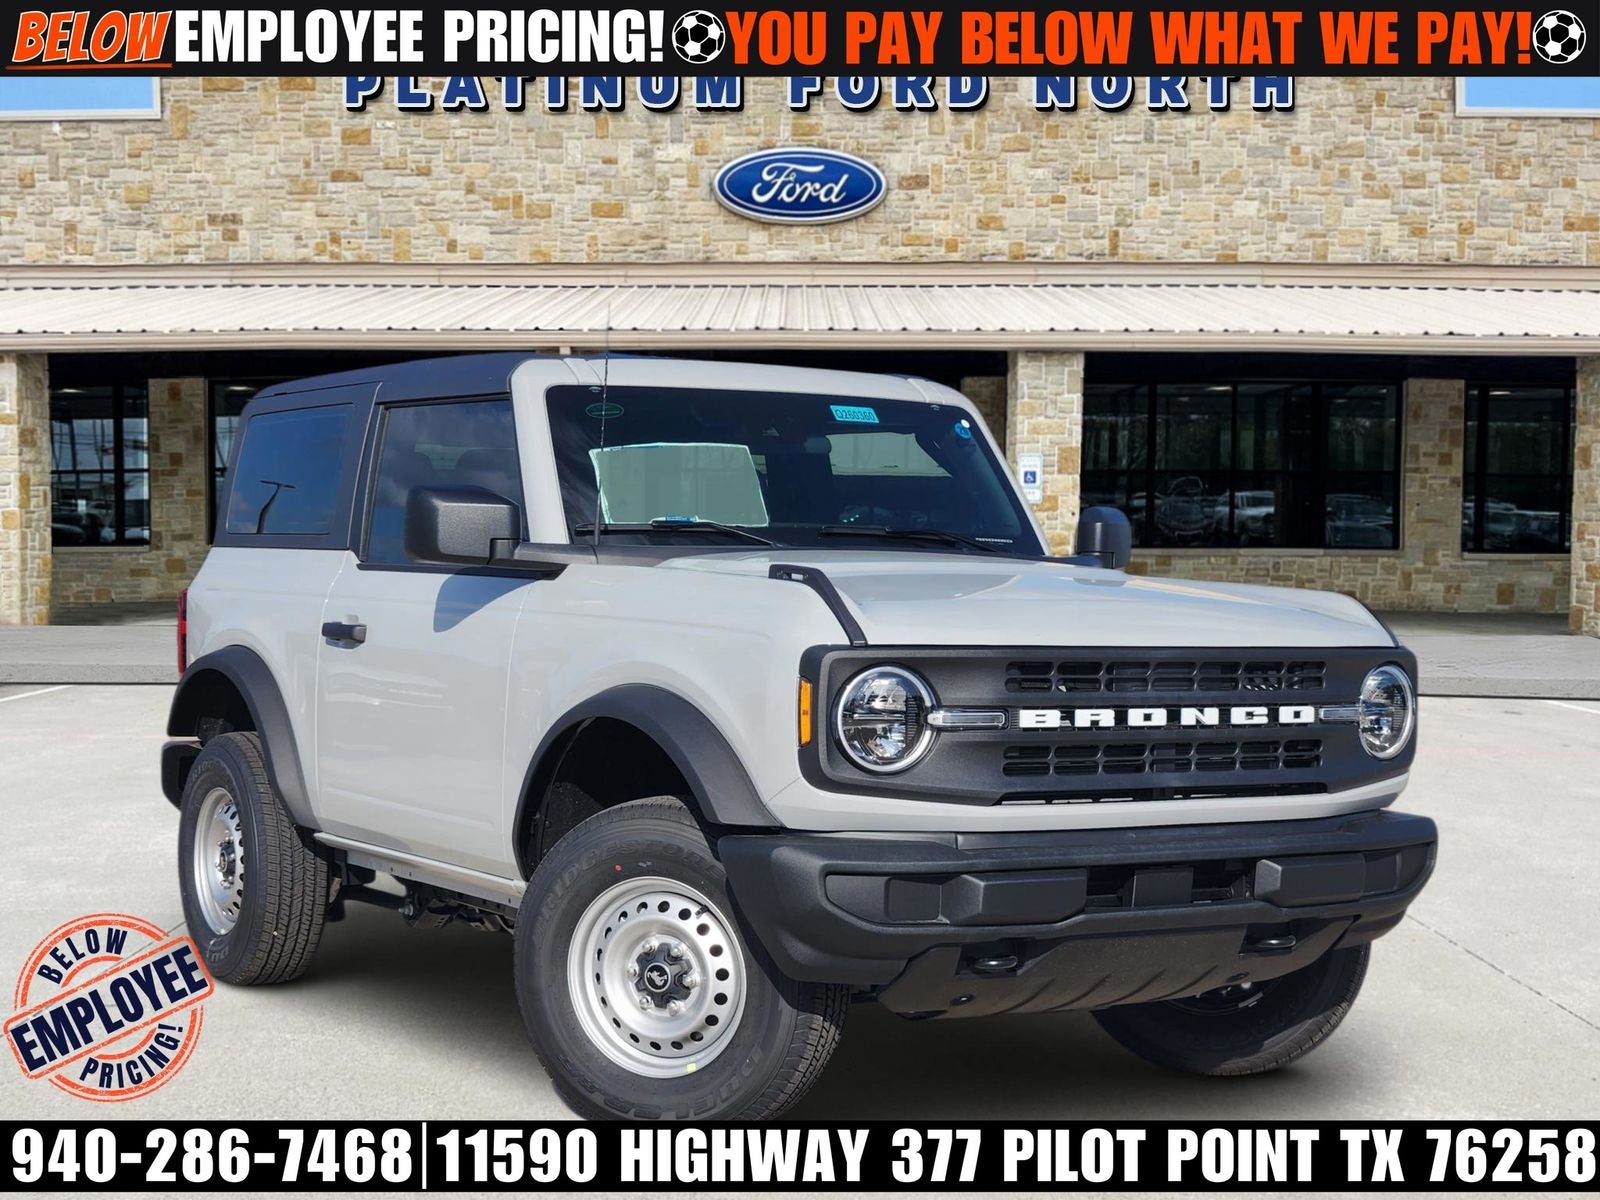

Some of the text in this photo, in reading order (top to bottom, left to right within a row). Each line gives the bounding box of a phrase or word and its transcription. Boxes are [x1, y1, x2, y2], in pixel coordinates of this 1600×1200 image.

[342, 76, 1297, 110] PLATINUM FORD NORTH
[751, 161, 849, 203] Ford
[1018, 705, 1315, 729] BRONCO
